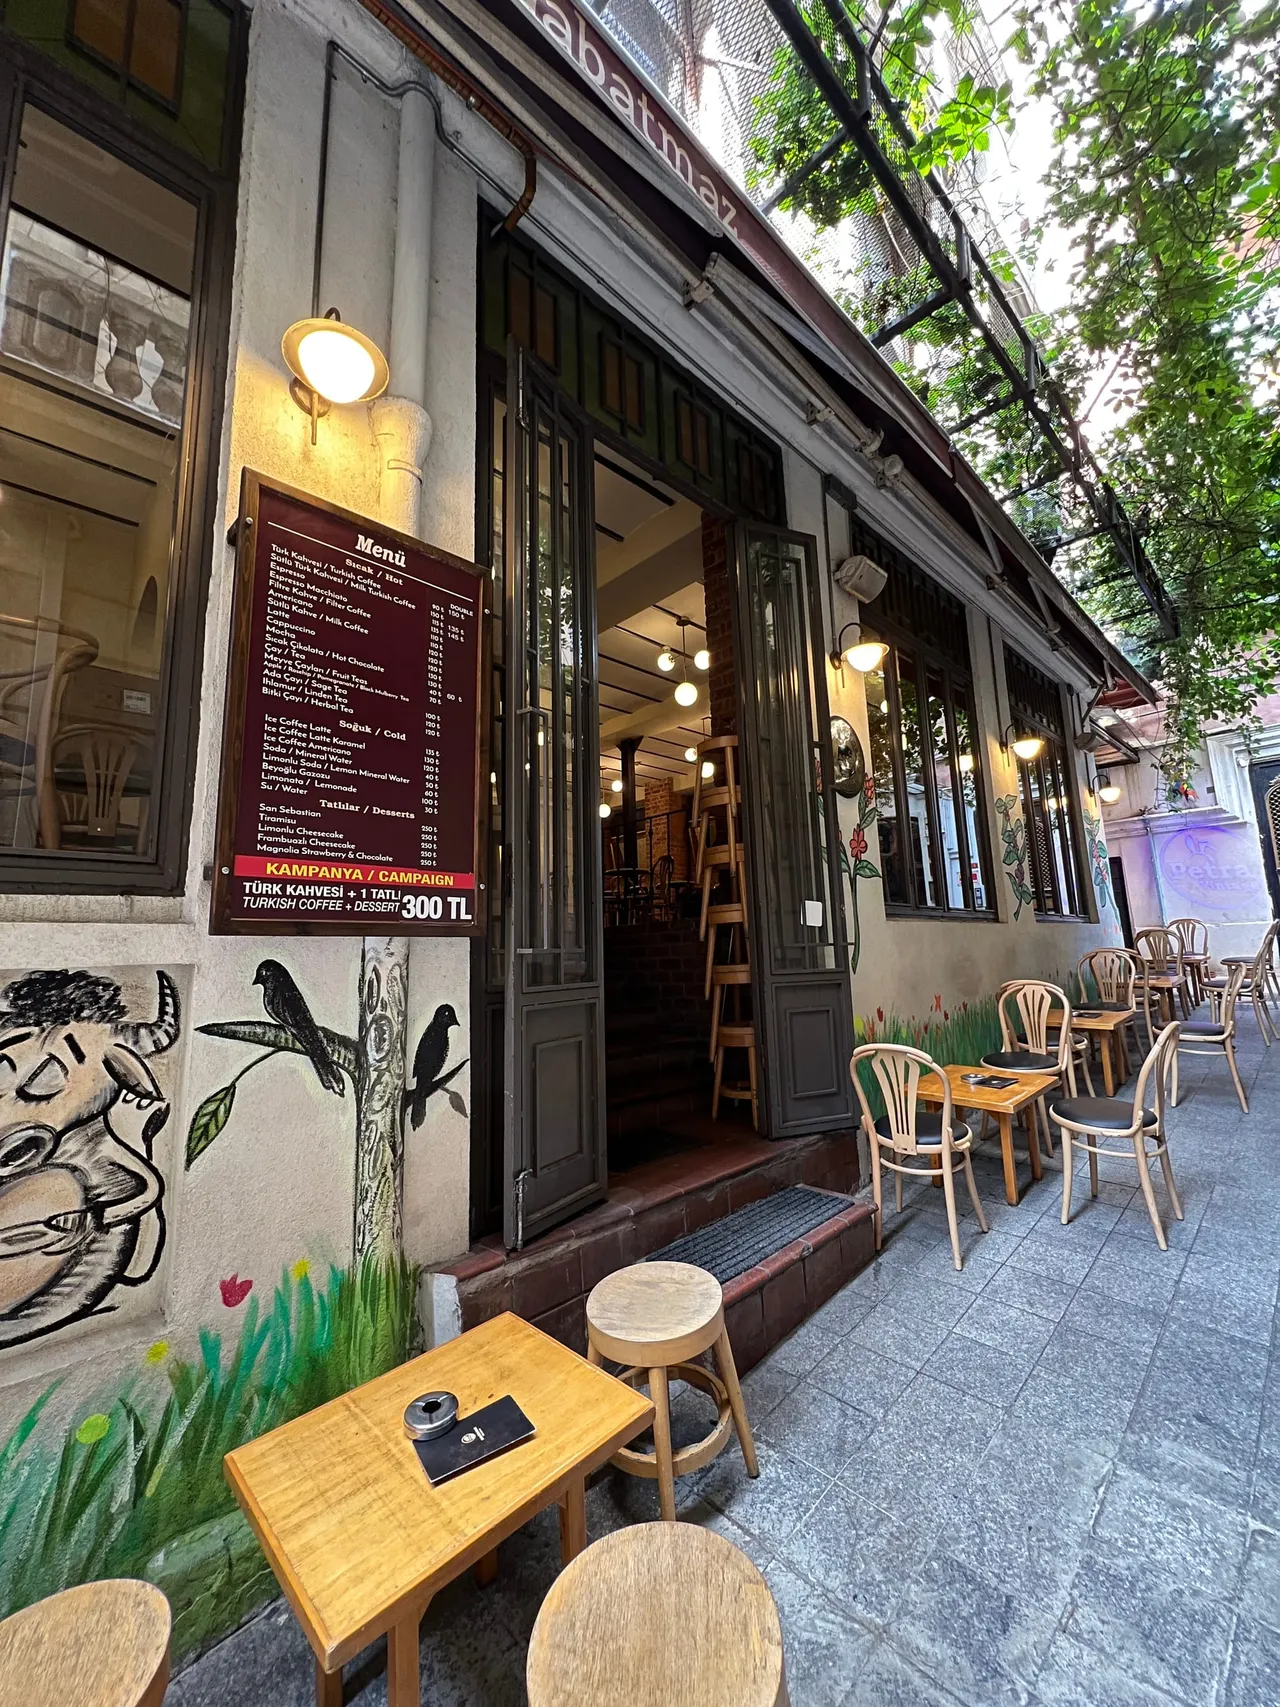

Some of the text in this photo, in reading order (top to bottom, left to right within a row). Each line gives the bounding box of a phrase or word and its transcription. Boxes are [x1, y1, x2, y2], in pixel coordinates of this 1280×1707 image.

[520, 0, 739, 239] abatmaz
[355, 534, 406, 568] Menü
[270, 561, 305, 579] Espresso
[271, 543, 289, 556] Türk
[291, 550, 322, 568] Kahvesi
[329, 564, 356, 580] Turkish
[357, 575, 381, 589] Coffee
[269, 570, 348, 602] Espresso Macchiato
[294, 560, 311, 573] Türk
[313, 567, 343, 583] Kahvesi
[350, 581, 366, 592] Milk
[367, 586, 392, 601] Turkish
[393, 596, 416, 609] Coffee
[385, 573, 403, 585] Hot
[268, 588, 313, 608] Americano
[268, 579, 290, 592] Filtre
[292, 586, 317, 601] Kahve
[325, 597, 345, 609] Filter
[346, 605, 371, 618] Coffee
[267, 605, 290, 619] Latte
[291, 604, 317, 618] Kahve
[325, 615, 342, 626] Milk
[343, 621, 368, 634] Coffee
[450, 603, 473, 616] DOUBLE
[266, 615, 315, 635] Cappuccino
[266, 624, 296, 639] Mocha
[264, 642, 282, 654] Çay
[290, 649, 305, 659] Tea
[289, 640, 324, 655] Çikolata
[332, 652, 346, 661] Hot
[347, 656, 384, 672] Chocolate
[264, 652, 293, 665] Meyve
[332, 669, 350, 680] Fruit
[351, 674, 367, 685] Teas
[262, 668, 281, 678] Ada
[311, 679, 332, 691] Sage
[333, 684, 347, 694] Tea
[262, 686, 281, 697] Bitki
[311, 697, 338, 710] Herbal
[339, 704, 354, 713] Tea
[304, 687, 332, 700] Linden
[334, 694, 348, 703] Tea
[265, 713, 331, 734] Ice Coffee Latte
[263, 732, 351, 756] Ice Coffee Americano
[264, 723, 365, 749] Ice Coffee Latte Karamel
[383, 729, 406, 741] Cold
[263, 742, 286, 753] Soda
[295, 748, 327, 760] Mineral
[328, 754, 352, 764] Water
[262, 752, 298, 765] Limonlu
[299, 758, 322, 769] Soda
[330, 763, 357, 775] Lemon
[359, 769, 387, 780] Mineral
[388, 773, 410, 783] Water
[298, 768, 330, 779] Gazozu
[260, 781, 272, 790] Su
[281, 784, 308, 794] Water
[261, 771, 304, 785] Limonata
[314, 779, 357, 793] Lemonade
[259, 803, 321, 817] San Sebastian
[259, 812, 296, 824] Tiramisu
[372, 806, 415, 819] Desserts
[258, 823, 344, 839] Limonlu Cheesecake
[256, 843, 299, 854] Magnolia
[301, 847, 346, 859] Strawberry
[355, 852, 393, 862] Chocolate
[308, 838, 355, 849] Cheesecake
[266, 862, 363, 880] KAMPANYA
[378, 870, 453, 886] CAMPAIGN
[1168, 862, 1256, 880] Petra
[243, 880, 282, 895] TÜRK
[286, 884, 343, 897] KAHVESİ
[243, 896, 296, 909] TURKISH
[298, 898, 343, 910] COFFEE
[354, 900, 400, 912] DESSERT
[401, 894, 472, 920] 300 TL
